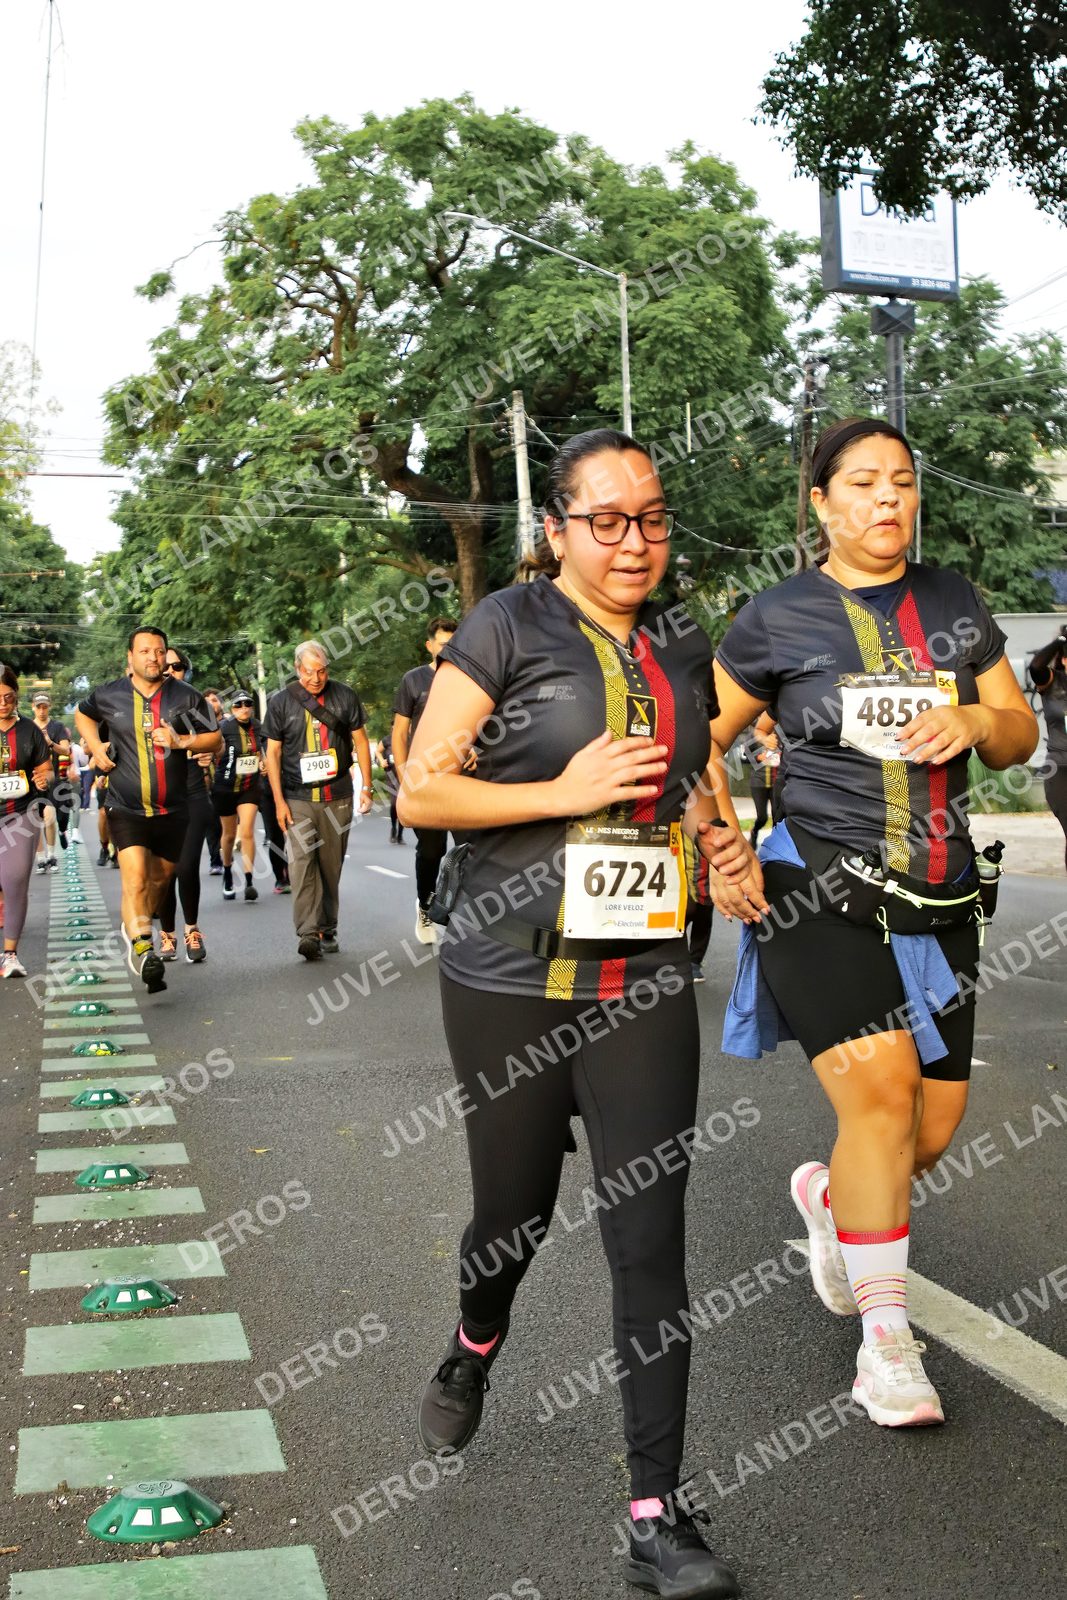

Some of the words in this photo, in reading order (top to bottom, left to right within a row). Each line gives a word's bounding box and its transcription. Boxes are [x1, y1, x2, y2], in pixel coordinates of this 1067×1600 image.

[938, 677, 952, 688] 5K
[306, 759, 330, 771] 2908
[583, 859, 667, 897] 6724
